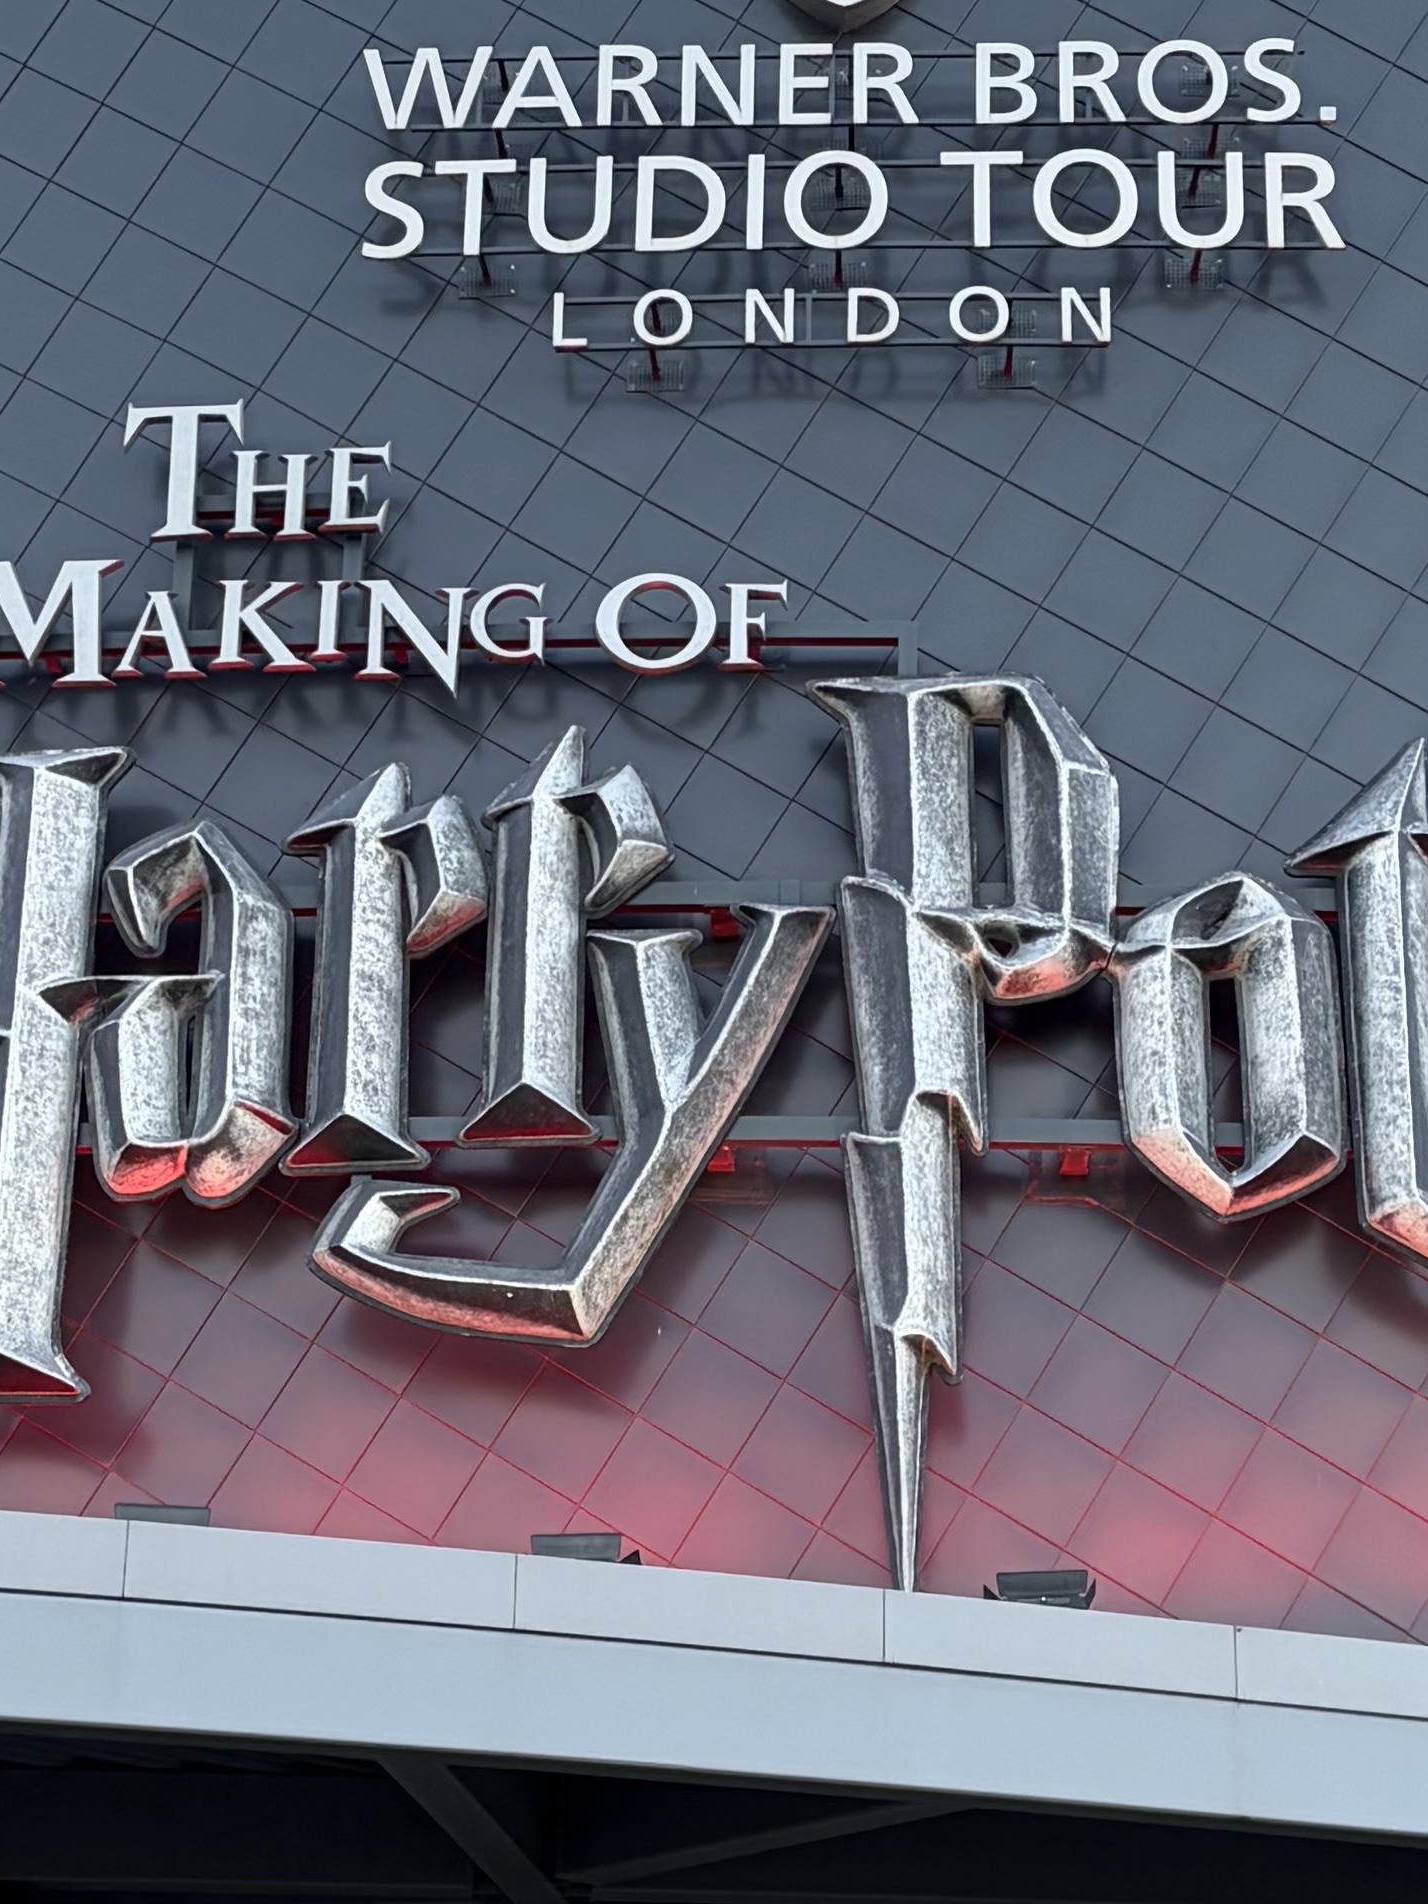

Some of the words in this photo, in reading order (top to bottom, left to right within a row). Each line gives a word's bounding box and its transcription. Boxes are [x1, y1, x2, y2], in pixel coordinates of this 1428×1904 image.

[363, 42, 920, 131] WARNER
[973, 37, 1338, 126] BROS.
[361, 151, 888, 260] STUDIO
[941, 149, 1346, 250] TOUR
[552, 286, 1113, 350] LONDON
